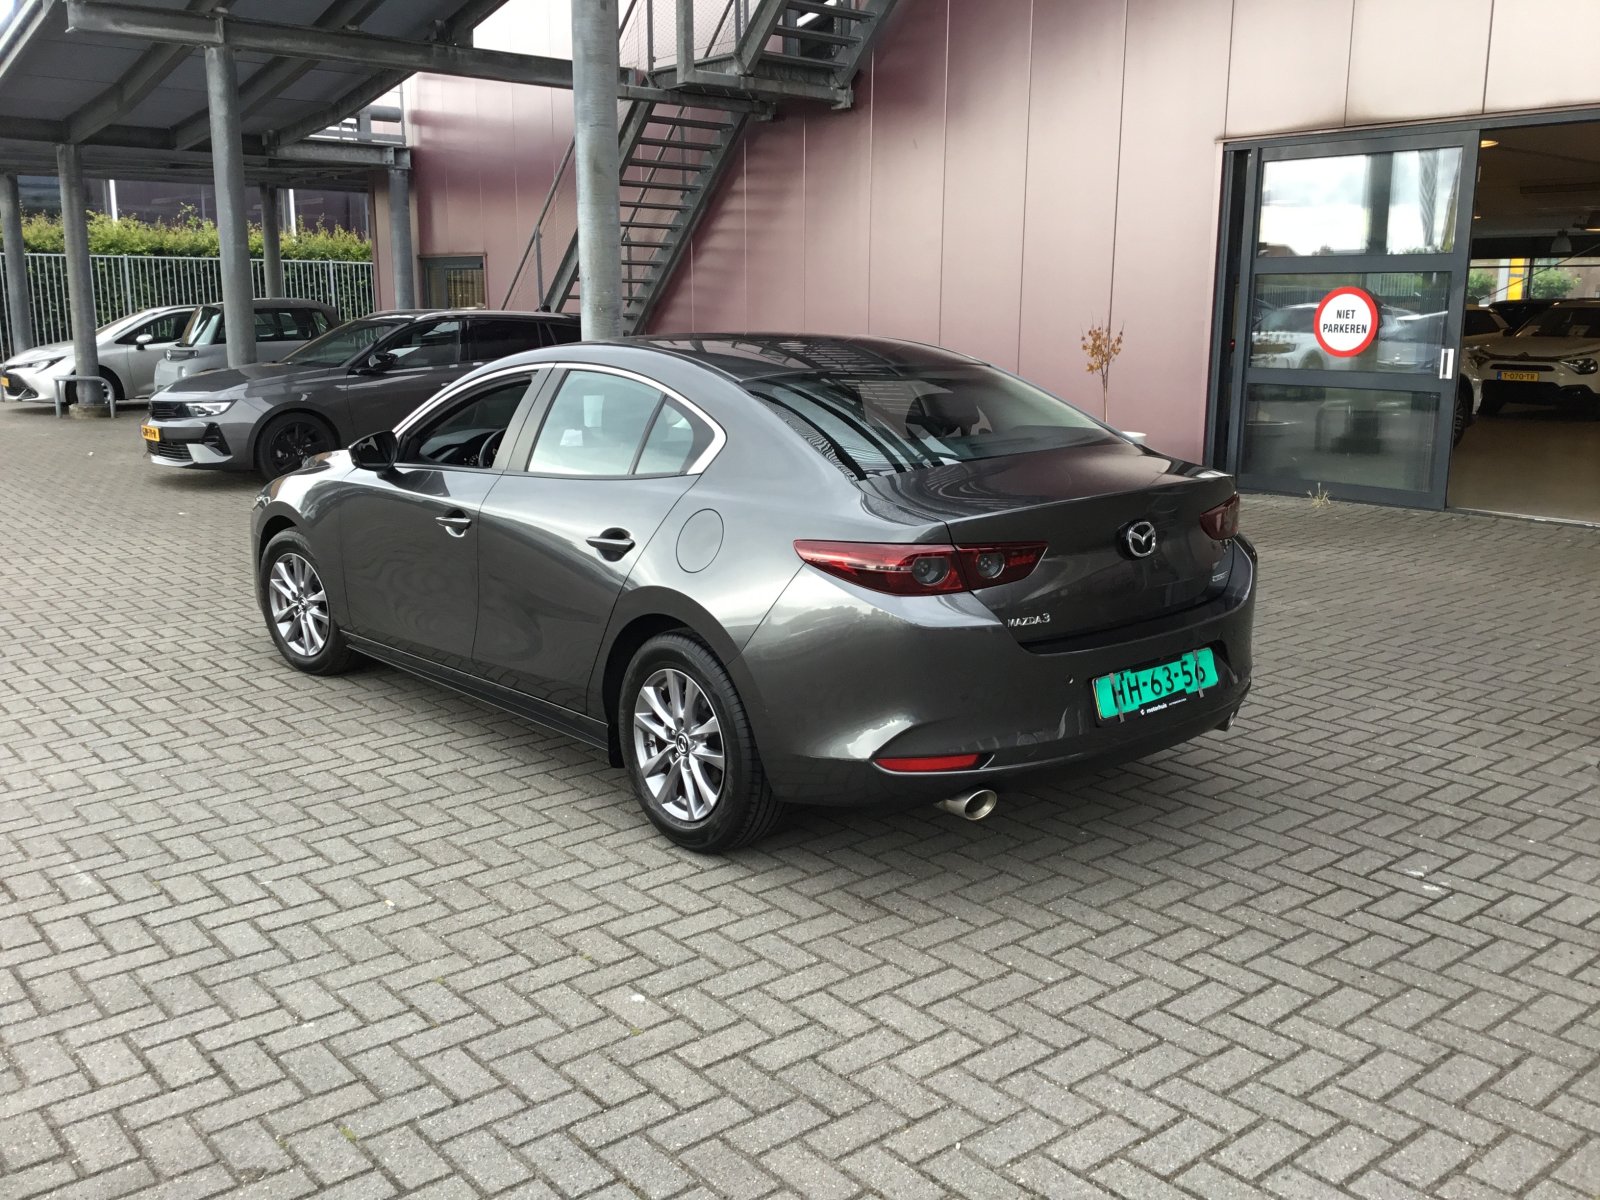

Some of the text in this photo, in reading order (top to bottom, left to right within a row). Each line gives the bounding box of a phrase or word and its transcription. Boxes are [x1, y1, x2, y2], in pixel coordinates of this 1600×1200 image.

[1336, 309, 1356, 319] NIET
[1323, 323, 1367, 334] PARKEREN
[1007, 612, 1051, 628] MAZDA3
[1111, 661, 1206, 708] HH-63-56
